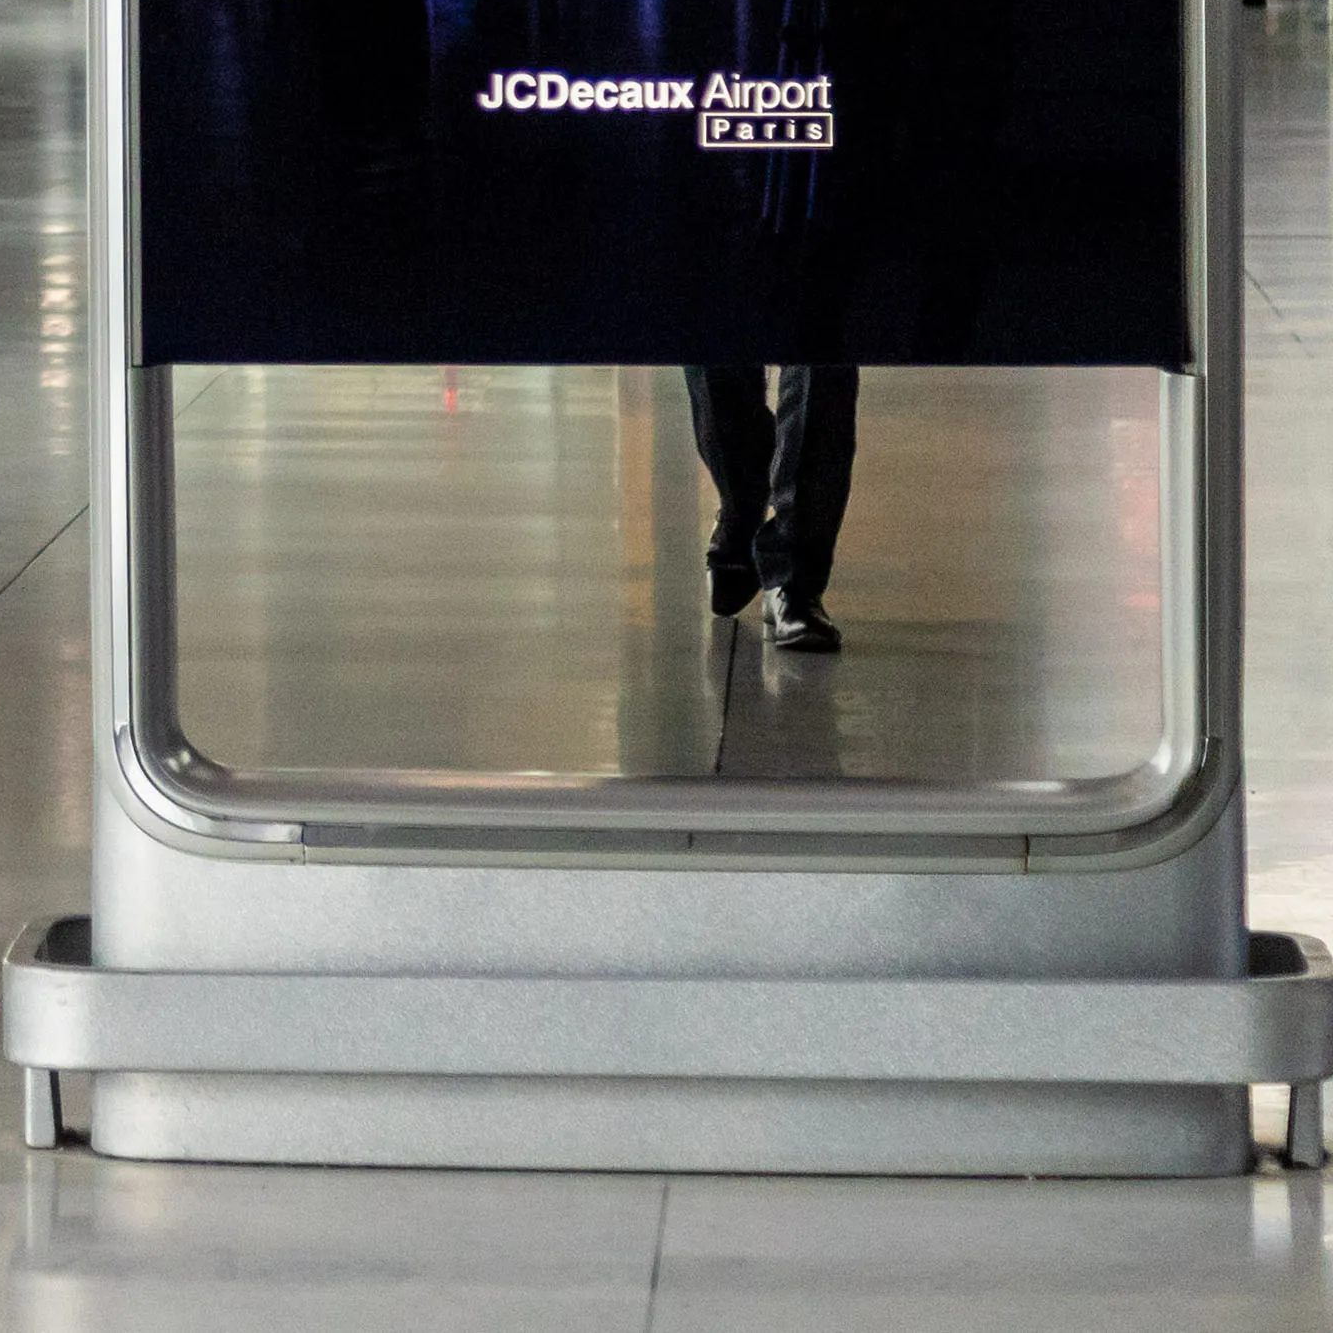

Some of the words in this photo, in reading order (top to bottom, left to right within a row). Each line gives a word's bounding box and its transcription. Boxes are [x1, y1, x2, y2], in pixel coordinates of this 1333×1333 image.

[480, 73, 695, 109] JCDecaux
[701, 73, 832, 113] Airport
[711, 119, 823, 140] Paris
